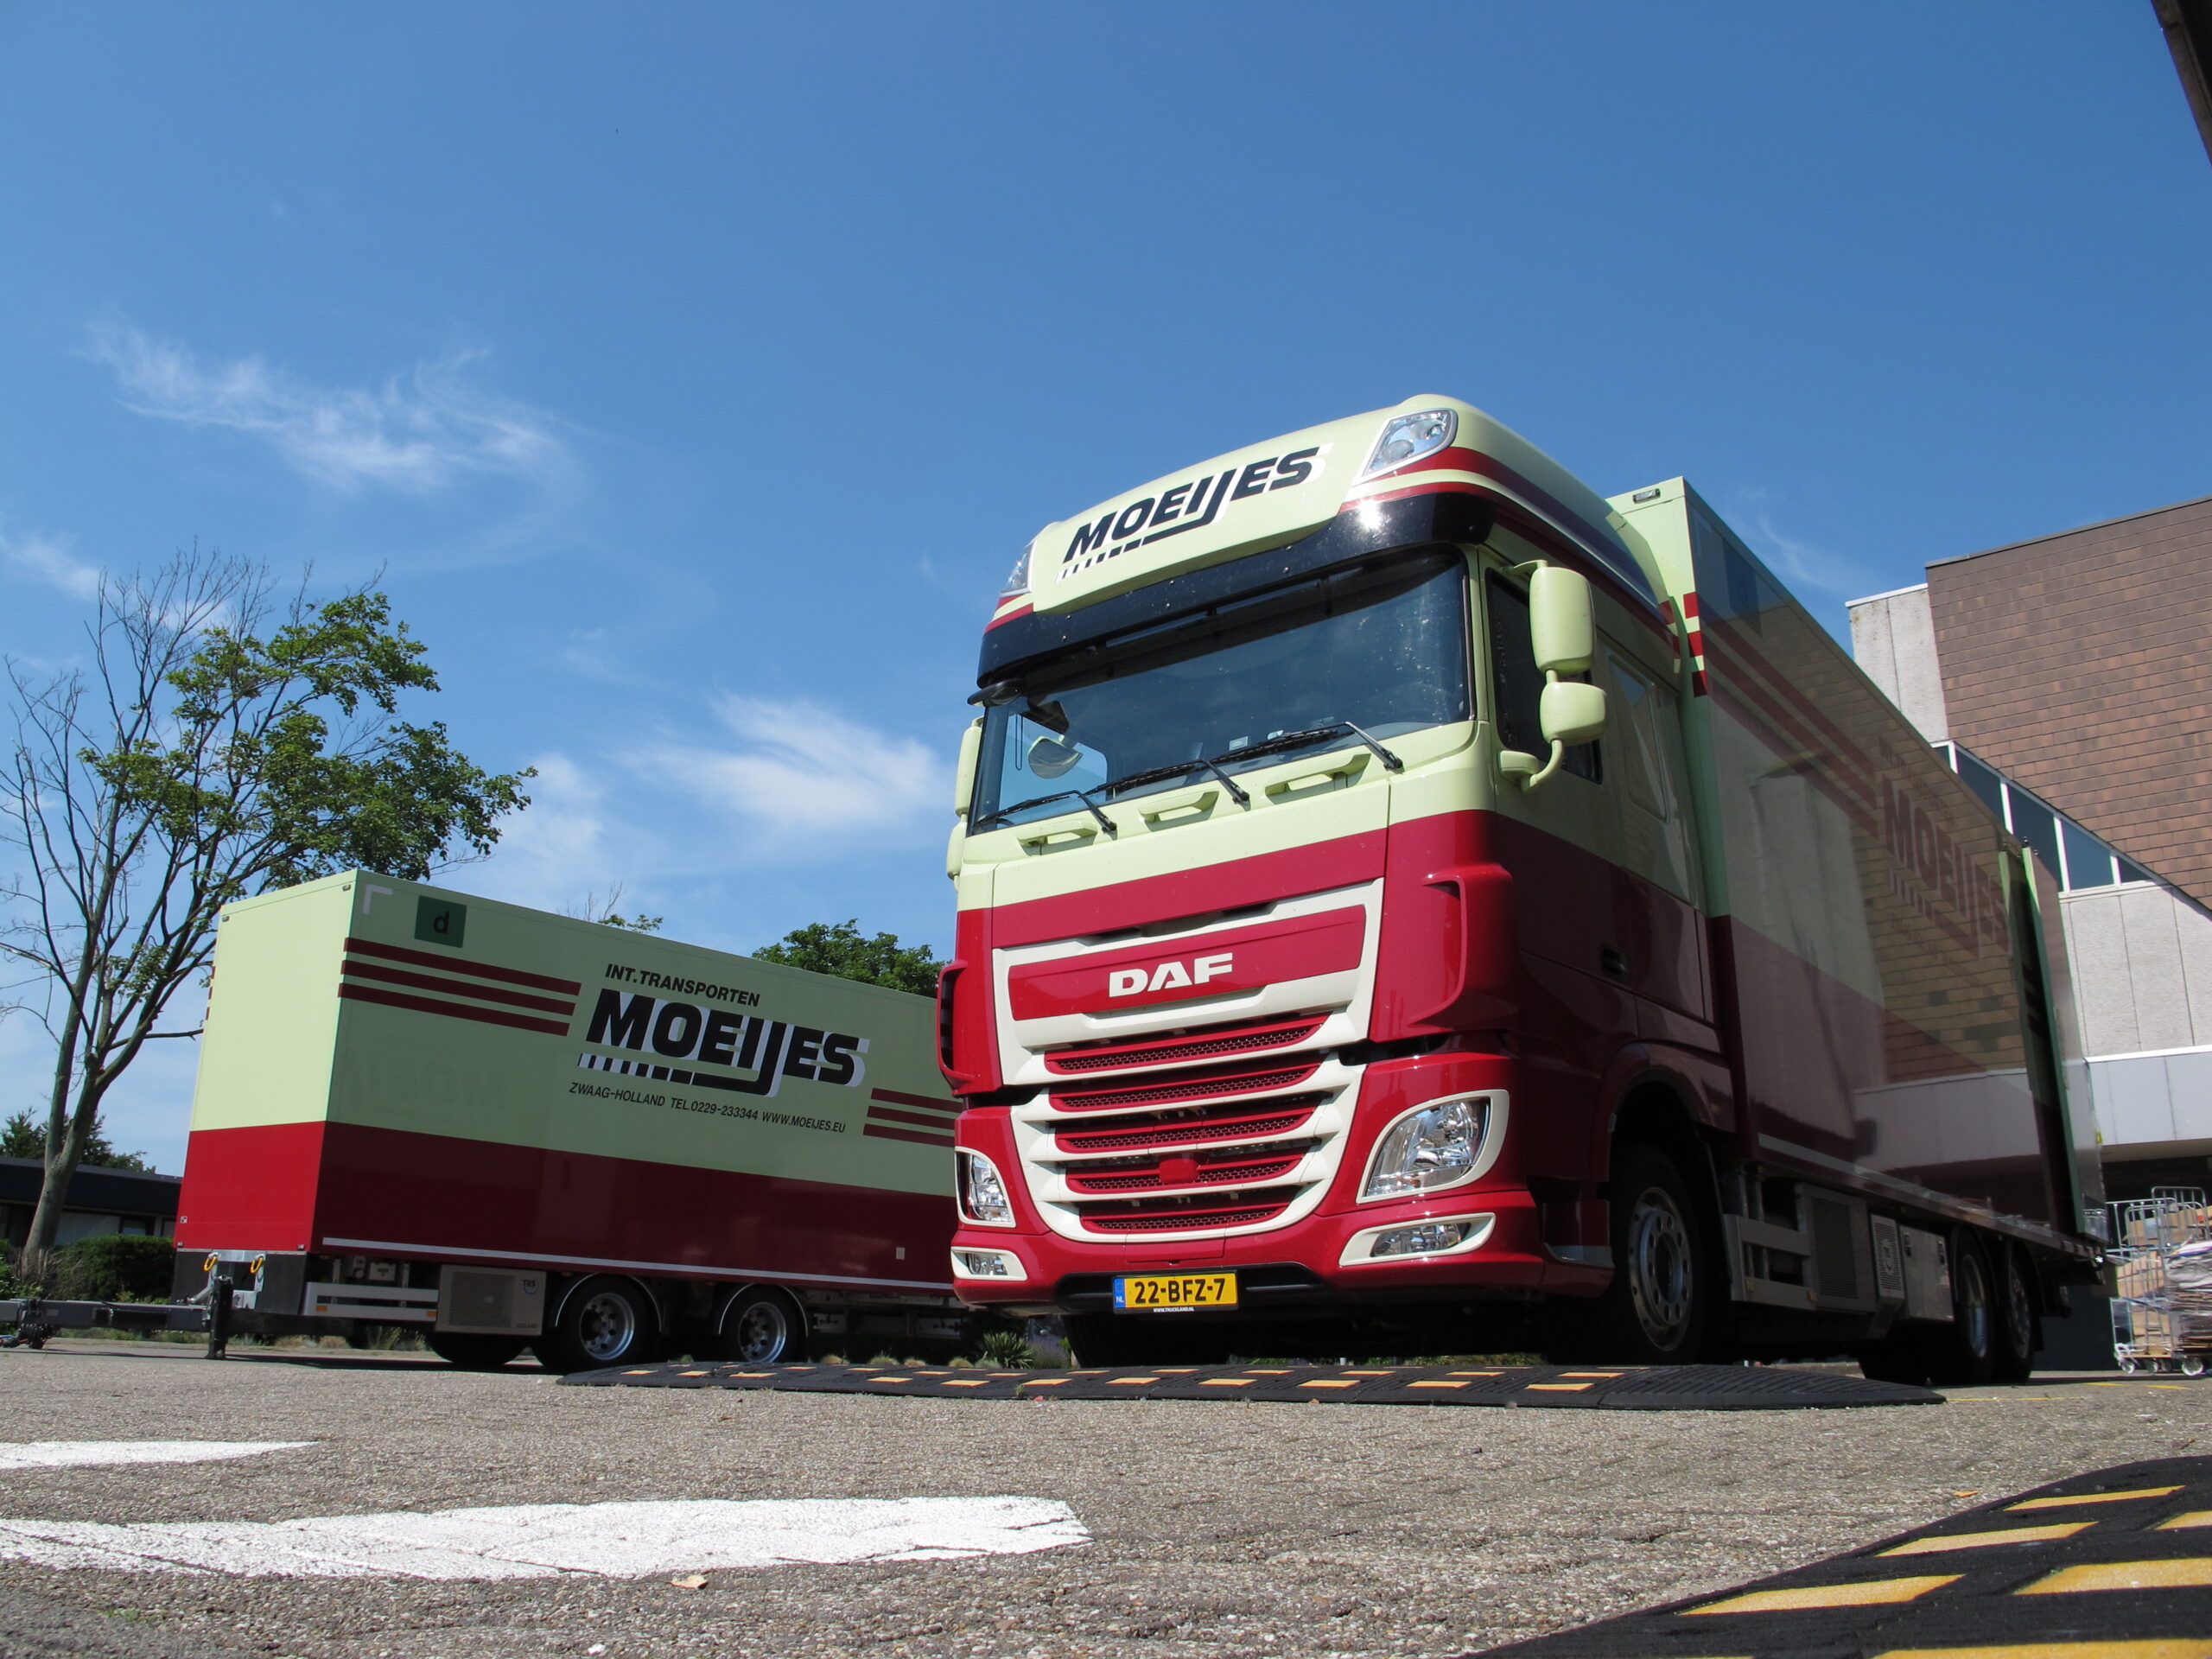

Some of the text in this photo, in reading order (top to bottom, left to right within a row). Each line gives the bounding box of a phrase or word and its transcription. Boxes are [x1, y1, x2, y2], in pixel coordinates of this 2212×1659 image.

[1063, 444, 1325, 563] MOEIJES
[433, 912, 450, 934] d
[1109, 952, 1233, 998] DAF
[585, 988, 868, 1097] MOEIJES
[569, 1082, 665, 1107] ZWAAG-HOLLAND
[762, 1111, 846, 1134] WWW.MOEIJES.EU
[1134, 1278, 1226, 1304] 22-BFZ-7
